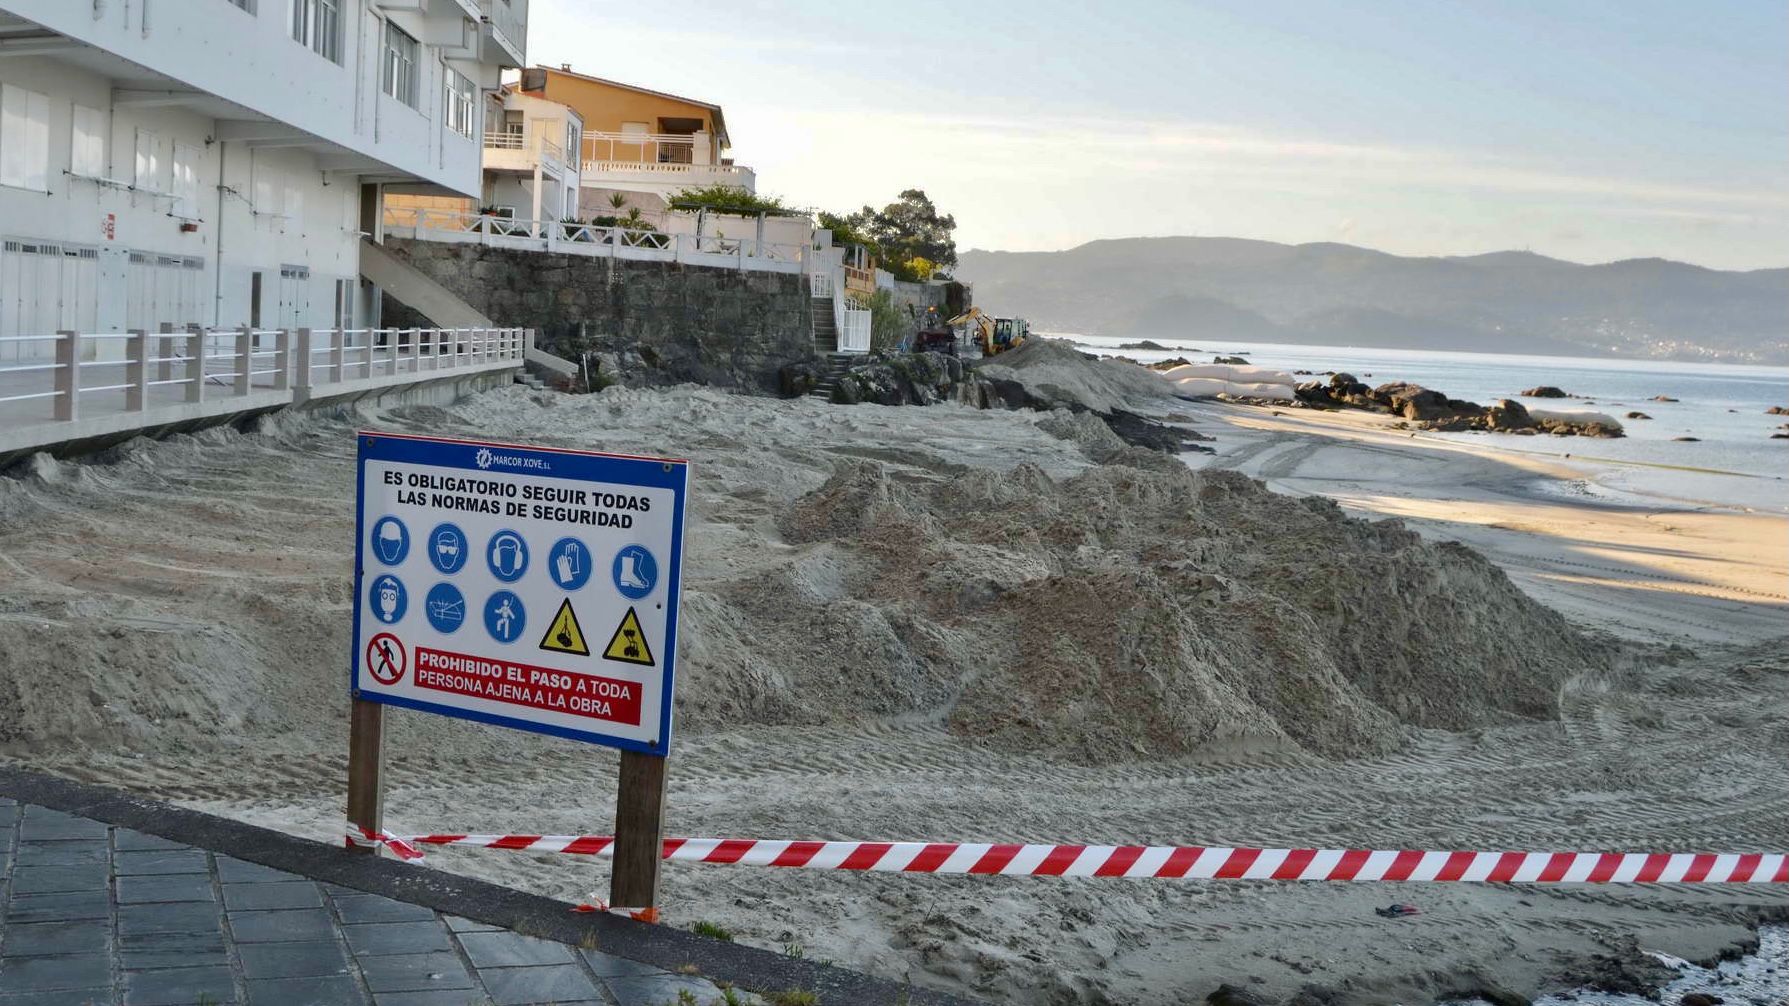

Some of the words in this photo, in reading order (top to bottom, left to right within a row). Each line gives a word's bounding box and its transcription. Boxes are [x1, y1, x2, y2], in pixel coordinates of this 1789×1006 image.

[493, 456, 522, 467] MARCOR
[384, 471, 403, 485] ES
[408, 473, 517, 497] OBLIGATORIO
[522, 485, 586, 505] SEGUIR
[592, 492, 650, 512] TODAS
[398, 490, 426, 506] LAS
[431, 494, 501, 514] NORMAS
[506, 502, 527, 517] DE
[533, 505, 633, 529] SEGURIDAD
[419, 670, 483, 693] PERSONA
[485, 682, 532, 702] AJENA
[534, 690, 544, 704] A
[548, 692, 566, 708] LA
[570, 696, 612, 716] OBRA
[420, 652, 502, 678] PROHIBIDO
[507, 666, 526, 682] EL
[530, 670, 572, 690] PASO
[576, 679, 587, 693] A
[590, 680, 631, 700] TODA
